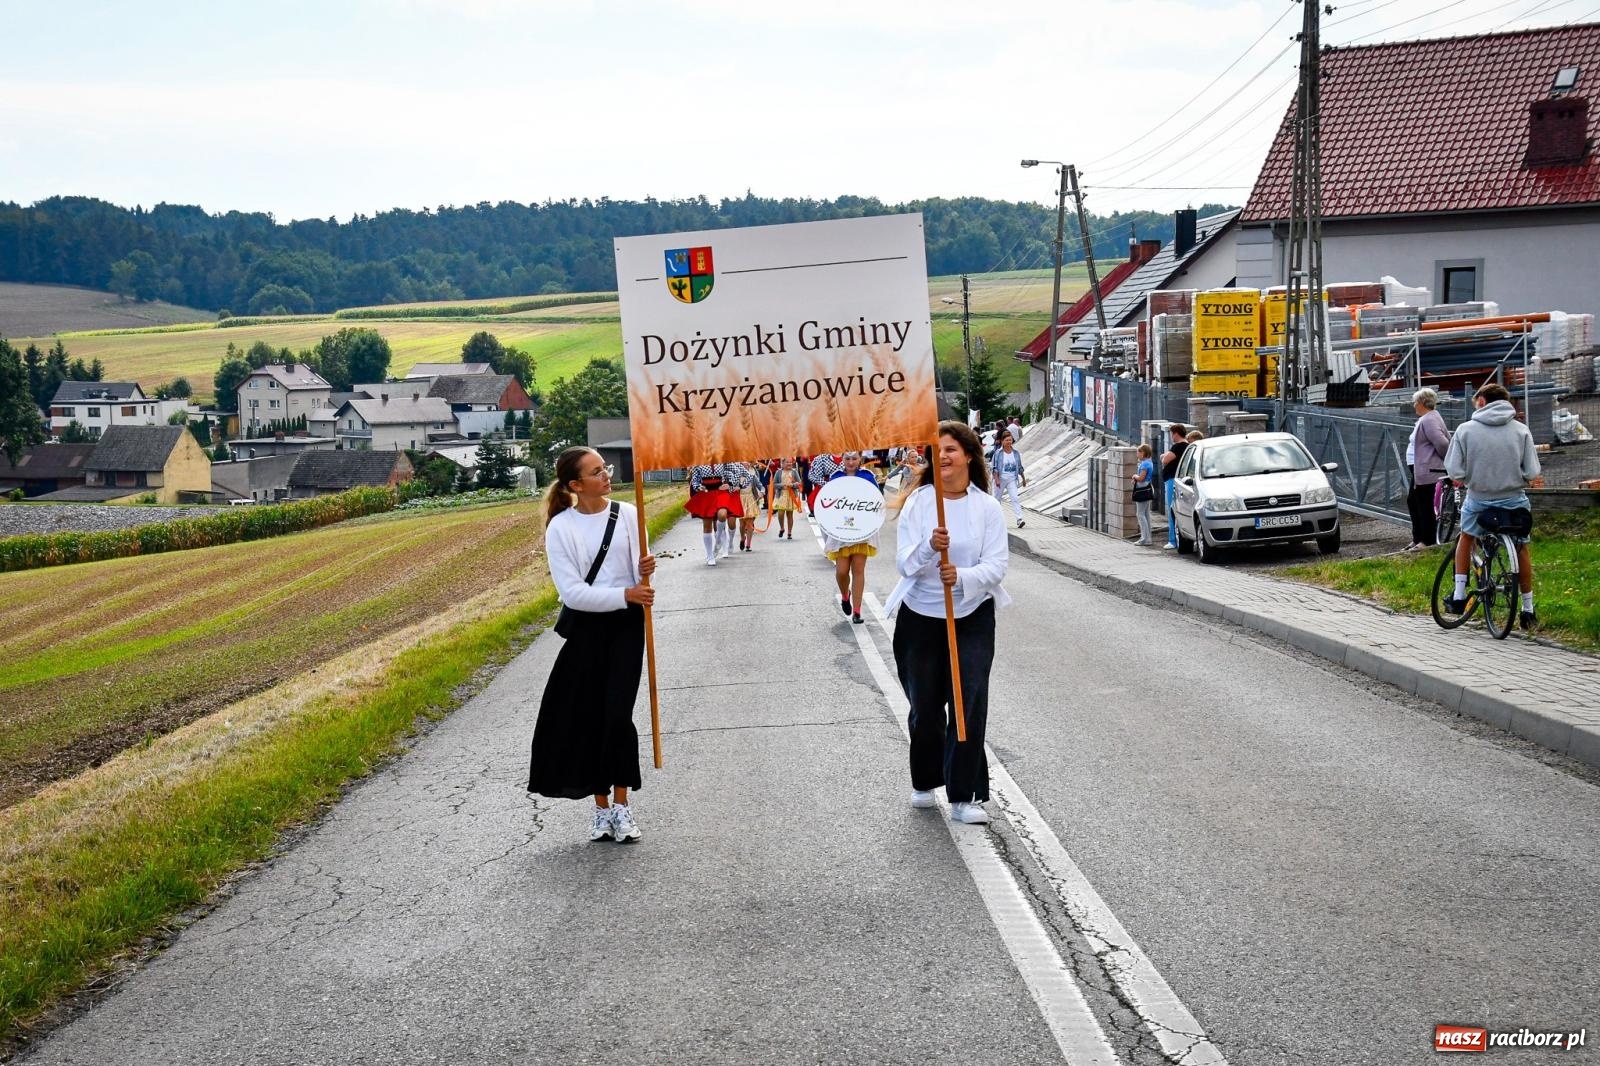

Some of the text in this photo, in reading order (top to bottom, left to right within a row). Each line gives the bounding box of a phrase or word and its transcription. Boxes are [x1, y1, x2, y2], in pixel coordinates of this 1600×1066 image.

[1201, 303, 1253, 314] YTONG
[641, 317, 912, 368] Dożynki Gminy
[1201, 337, 1253, 348] YTONG
[655, 367, 906, 417] Krzyżanowice
[1261, 515, 1299, 527] SRC CC53
